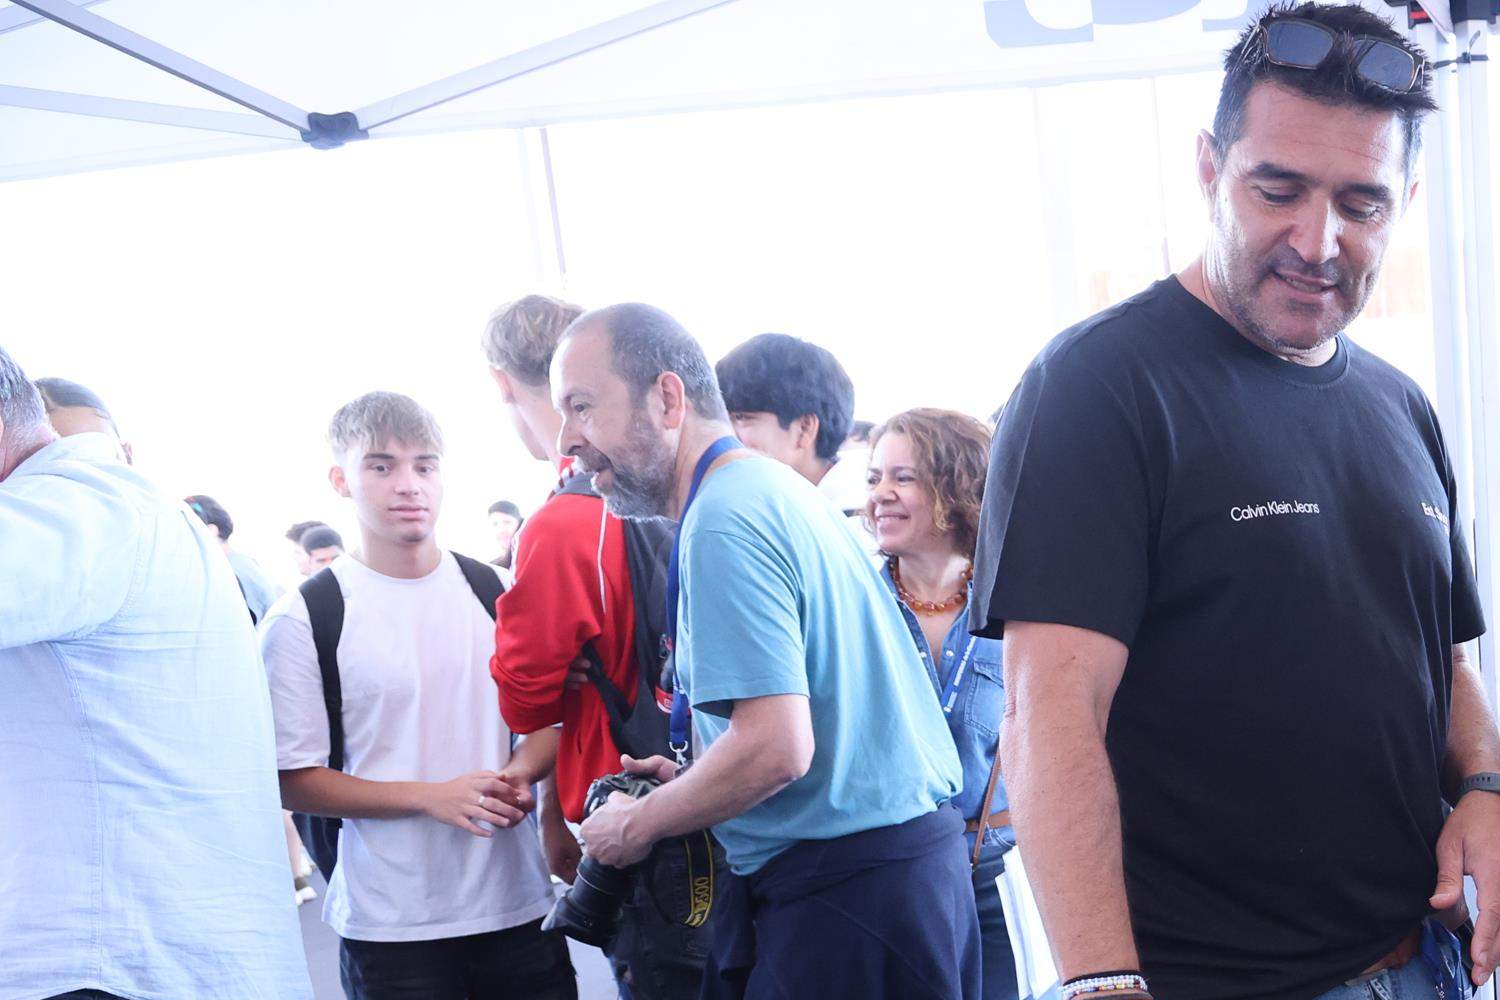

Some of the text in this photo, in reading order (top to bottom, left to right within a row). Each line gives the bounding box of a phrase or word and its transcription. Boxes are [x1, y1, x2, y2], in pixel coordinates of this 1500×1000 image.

[1230, 500, 1320, 521] Calvin Klein Jeans
